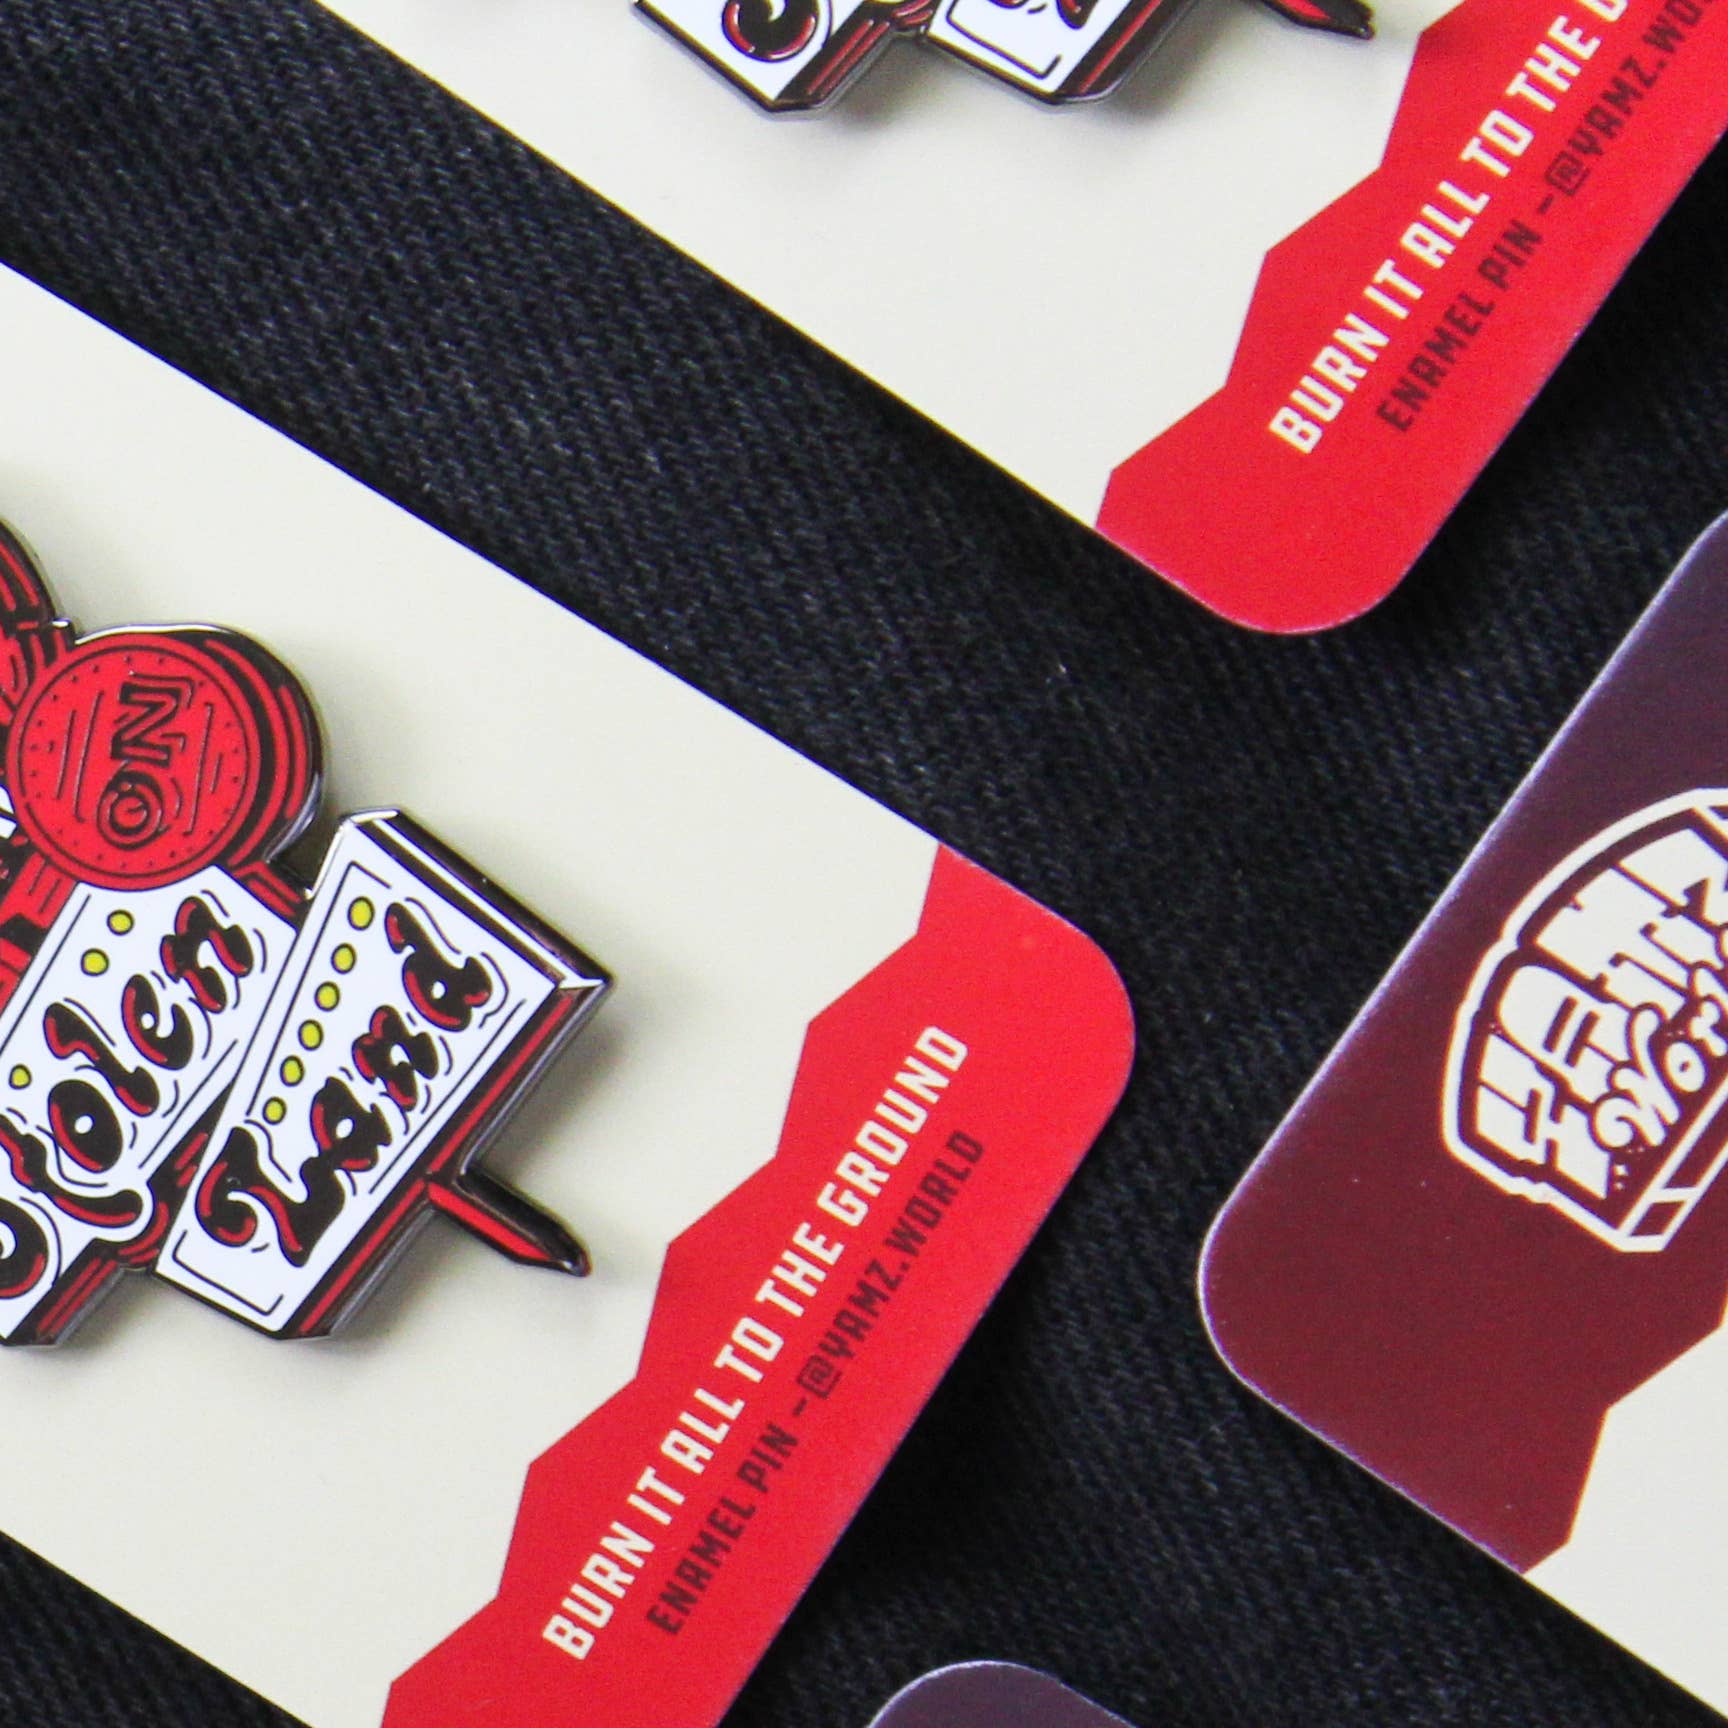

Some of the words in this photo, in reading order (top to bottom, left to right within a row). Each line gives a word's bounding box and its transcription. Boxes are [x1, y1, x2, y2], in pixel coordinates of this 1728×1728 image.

[1269, 314, 1387, 454] BURN
[1364, 259, 1421, 318] IT
[1402, 181, 1488, 267] ALL
[1461, 110, 1532, 176] TO
[1507, 16, 1598, 111] THE
[1377, 293, 1494, 431] ENAMEL
[1478, 219, 1541, 289] PIN
[96, 683, 182, 850] ON
[195, 904, 495, 1267] Land
[542, 1522, 652, 1660] BURN
[628, 1466, 683, 1524] IT
[662, 1388, 743, 1473] ALL
[715, 1316, 783, 1381] TO
[756, 1222, 842, 1316] THE
[818, 1029, 965, 1226] GROUND
[646, 1497, 756, 1635] ENAMEL
[737, 1423, 797, 1492] PIN
